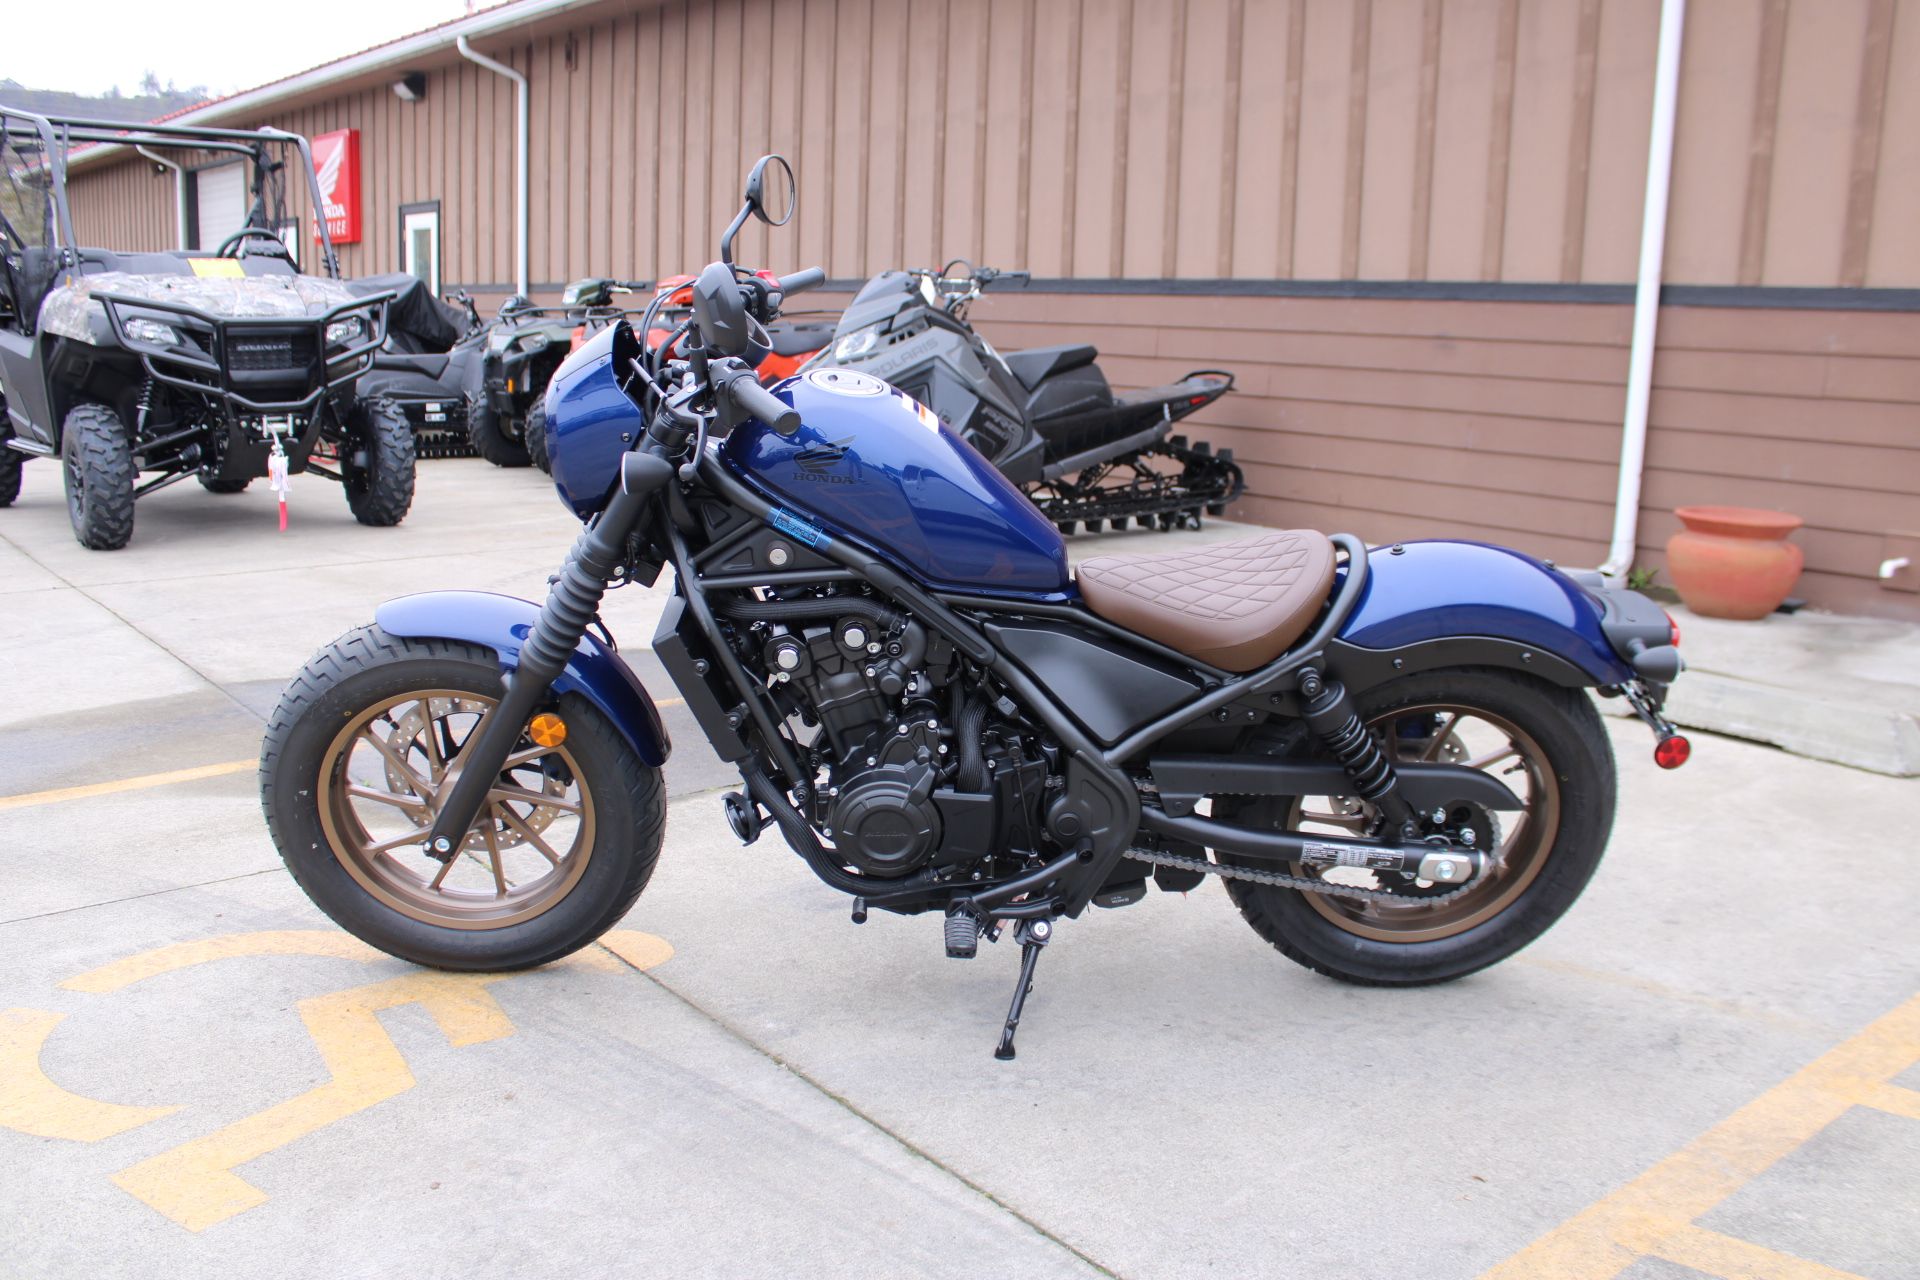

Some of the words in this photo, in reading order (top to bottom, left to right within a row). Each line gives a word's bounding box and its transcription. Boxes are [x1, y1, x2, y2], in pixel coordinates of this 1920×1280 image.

[313, 203, 346, 220] NDA
[312, 220, 347, 237] SVICE
[793, 471, 857, 485] HONDA
